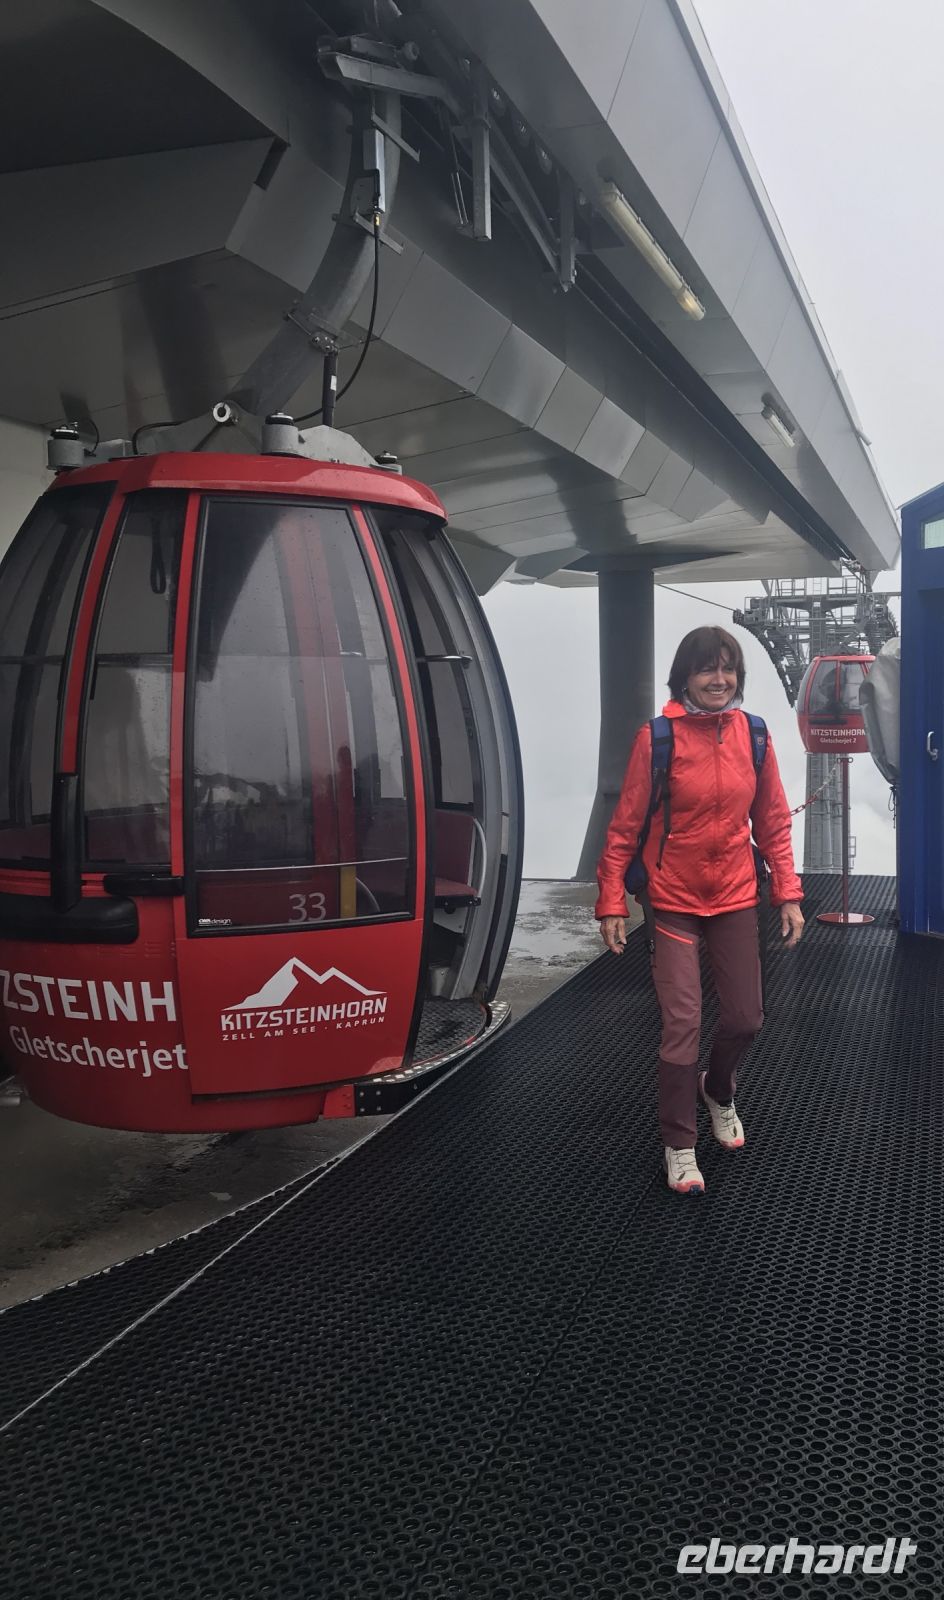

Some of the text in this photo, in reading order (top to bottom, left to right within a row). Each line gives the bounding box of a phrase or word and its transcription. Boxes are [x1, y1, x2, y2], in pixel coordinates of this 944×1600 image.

[288, 892, 327, 923] 33
[0, 969, 177, 1022] ZSTEINH
[220, 997, 388, 1032] KITZSTEINHORN
[222, 1016, 385, 1041] ZELL AM SEE KAPRUN
[9, 1025, 189, 1077] Gletscherjet
